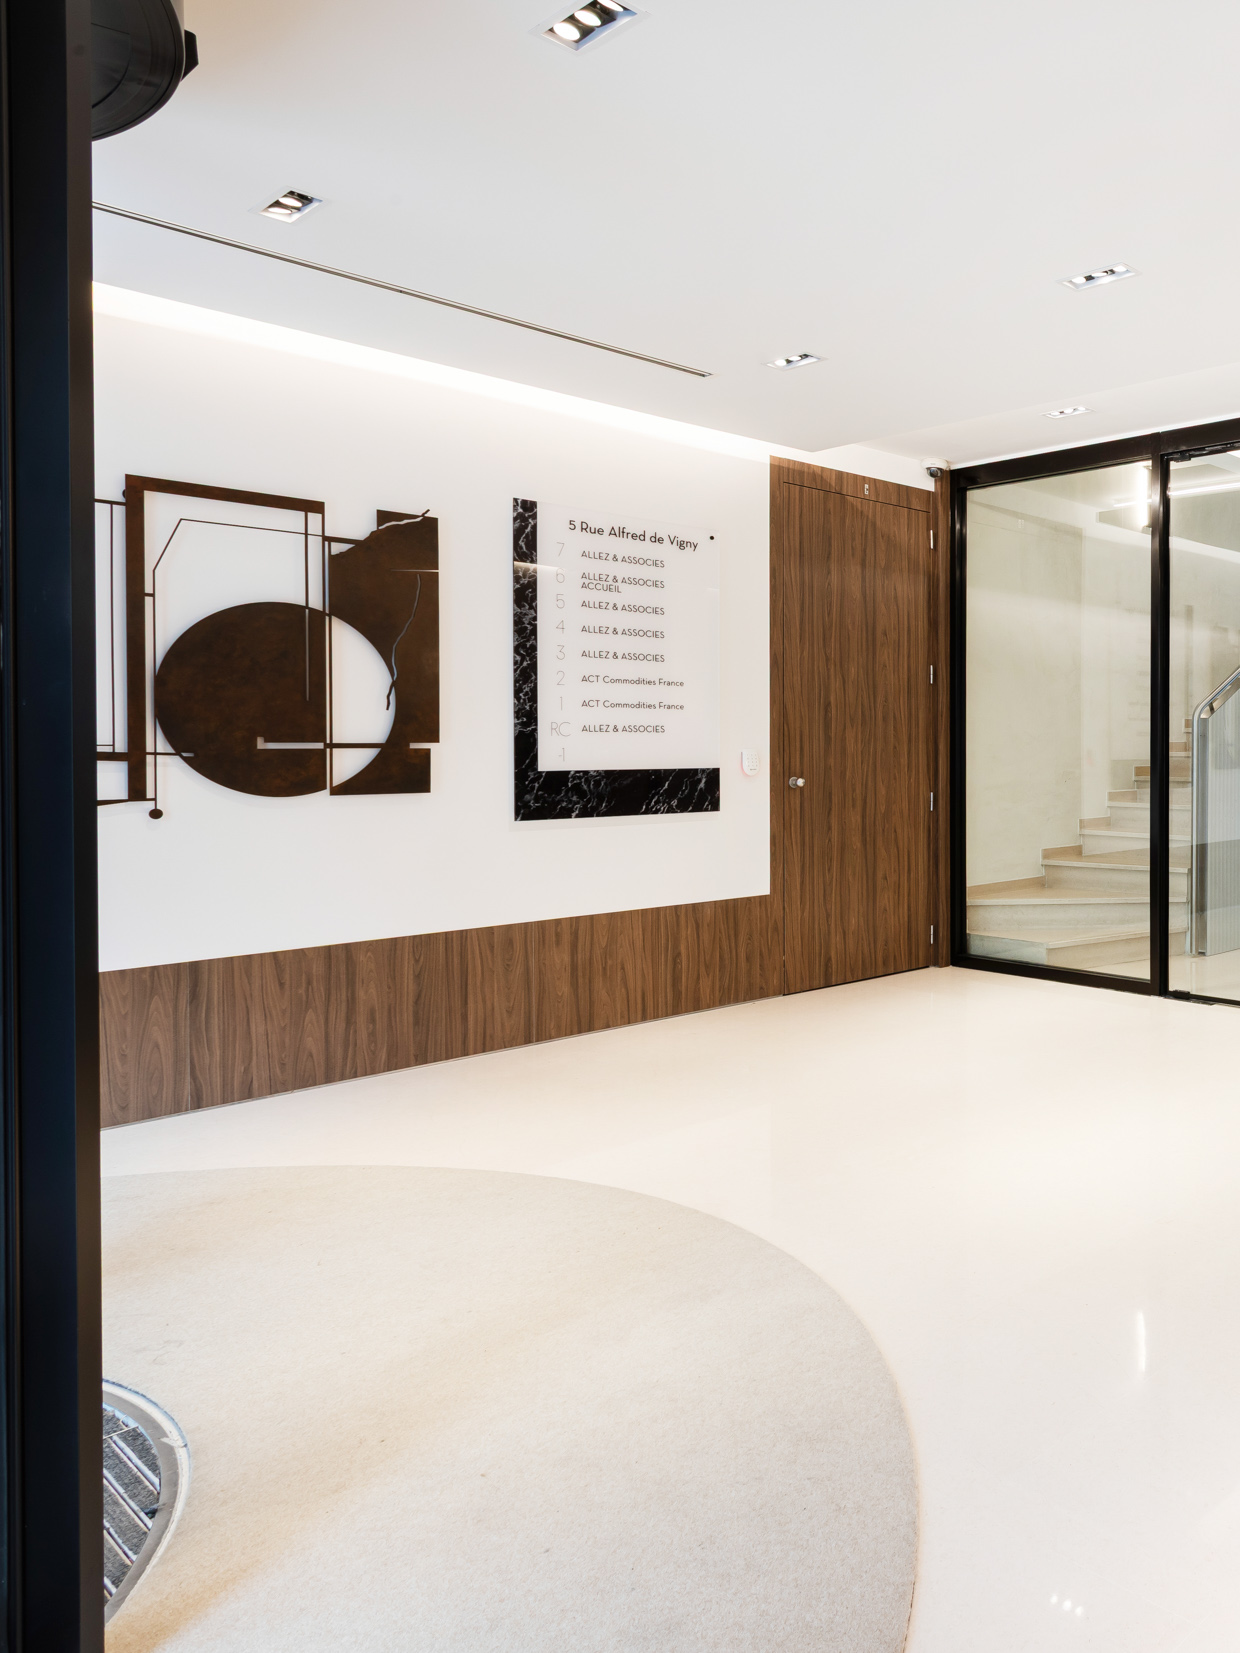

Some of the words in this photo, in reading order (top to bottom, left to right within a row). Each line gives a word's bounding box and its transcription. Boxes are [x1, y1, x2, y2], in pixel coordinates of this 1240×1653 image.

[569, 520, 576, 530] 5
[581, 521, 604, 535] Rue
[608, 526, 646, 542] Alfred
[650, 532, 664, 544] de
[668, 535, 698, 551] Vigny
[557, 542, 565, 556] 7
[581, 550, 610, 561] ALLEZ
[612, 554, 618, 562] &
[621, 556, 665, 568] ASSOCIES
[556, 568, 565, 583] 6
[581, 572, 610, 582] ALLEZ
[621, 577, 665, 588] ASSOCIES
[581, 582, 622, 593] ACCUEIL
[556, 594, 565, 609] 5
[581, 600, 610, 610] ALLEZ
[621, 604, 665, 615] ASSOCIES
[556, 620, 565, 634] 4
[581, 625, 610, 634] ALLEZ
[621, 628, 665, 638] ASSOCIES
[556, 645, 565, 660] 3
[581, 651, 610, 659] ALLEZ
[621, 653, 665, 662] ASSOCIES
[557, 671, 565, 685] 2
[581, 675, 600, 683] ACT
[603, 676, 656, 686] Commodities
[658, 678, 684, 687] France
[603, 700, 656, 709] Commodities
[658, 702, 684, 710] France
[550, 722, 571, 737] RC
[581, 725, 610, 733] ALLEZ
[622, 725, 665, 733] ASSOCIES
